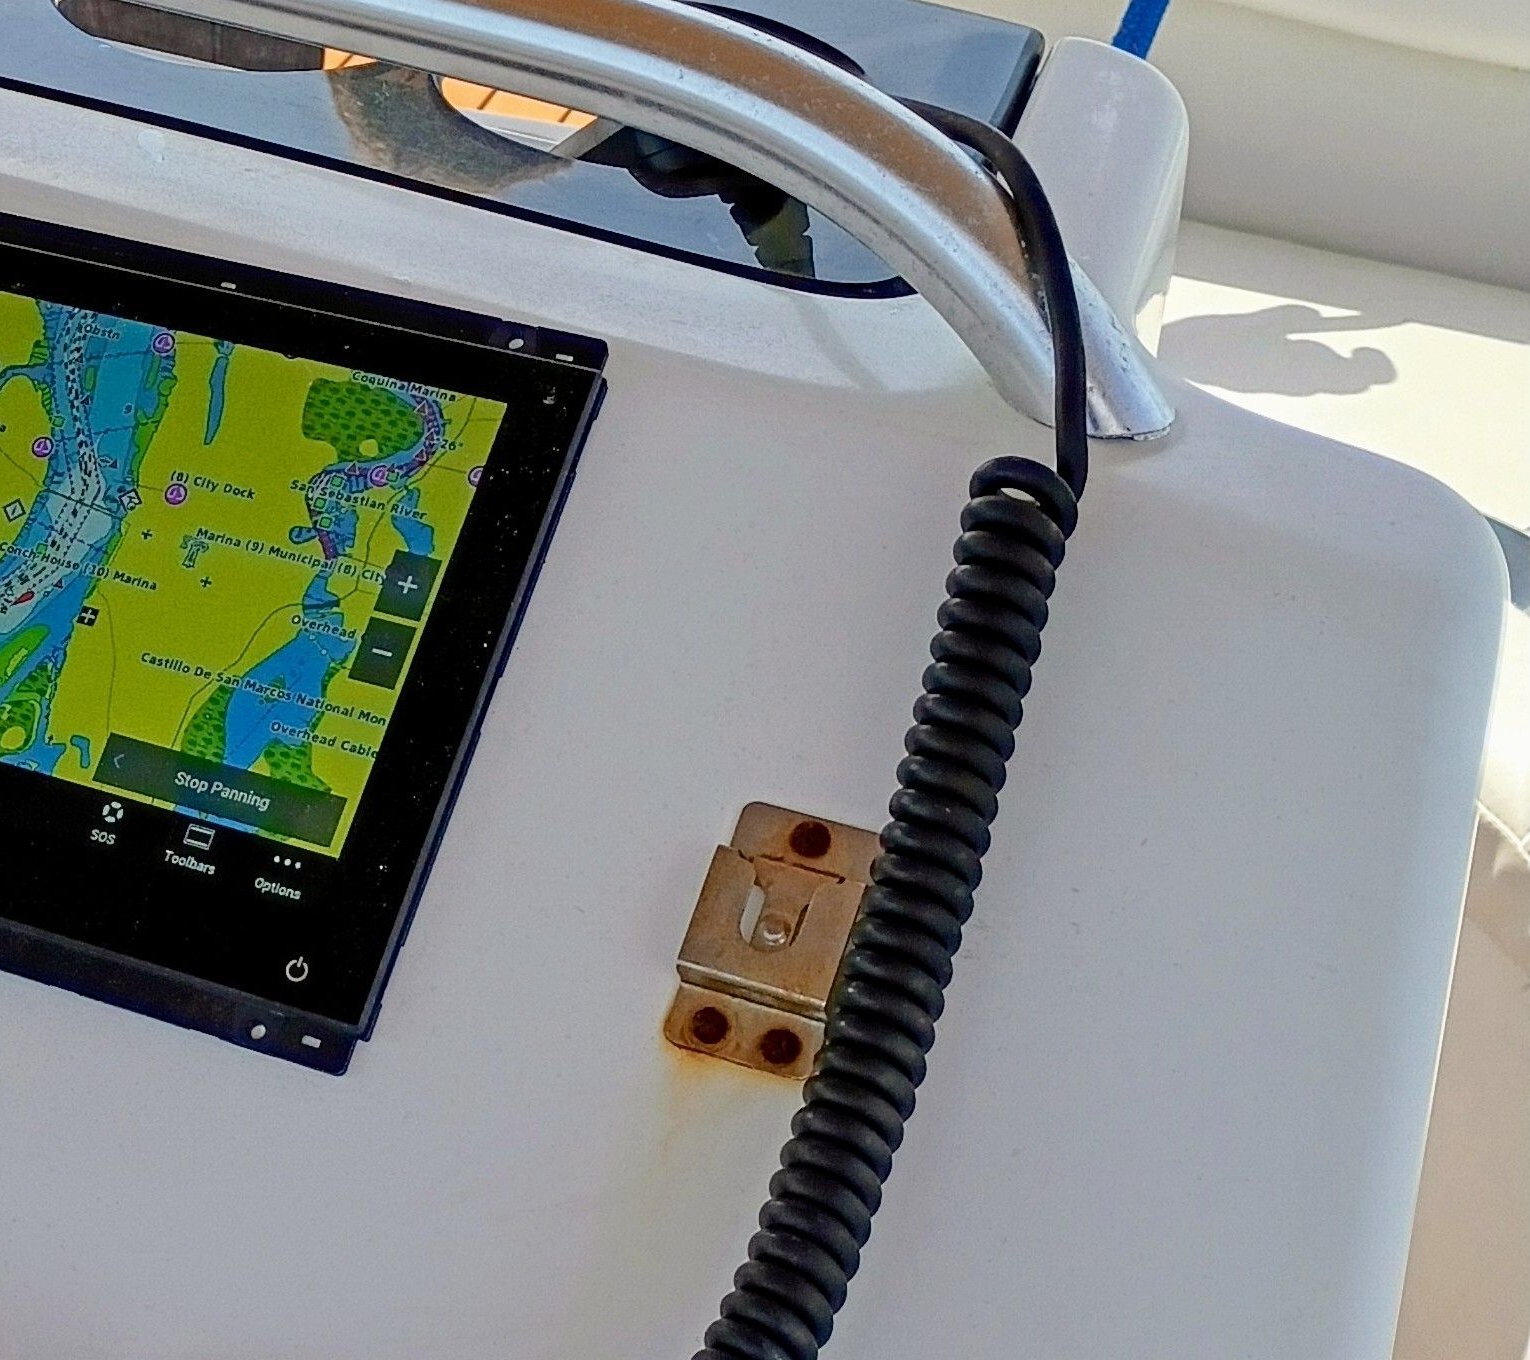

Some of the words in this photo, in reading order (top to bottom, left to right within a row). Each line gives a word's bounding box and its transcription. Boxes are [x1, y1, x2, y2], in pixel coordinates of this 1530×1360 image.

[351, 370, 407, 393] Coquina
[410, 384, 458, 403] Marina
[193, 476, 220, 493] City
[223, 483, 257, 501] Dock
[319, 486, 386, 512] Sebastian
[389, 504, 428, 522] River
[195, 527, 242, 548] Marina
[268, 545, 334, 572] Municipal
[0, 540, 37, 560] Conch
[81, 561, 110, 580] (10)
[112, 570, 158, 591] Marina
[290, 614, 357, 640] Overhead
[140, 652, 191, 674] Castillo
[193, 665, 212, 680] De
[215, 672, 241, 687] San
[243, 679, 292, 702] Marcos
[294, 693, 355, 719] National
[270, 721, 337, 748] Overhead
[173, 770, 210, 794] Stop
[209, 780, 272, 813] Panning
[89, 828, 116, 846] SOS
[164, 849, 217, 876] Toolbars
[254, 877, 303, 901] Options
